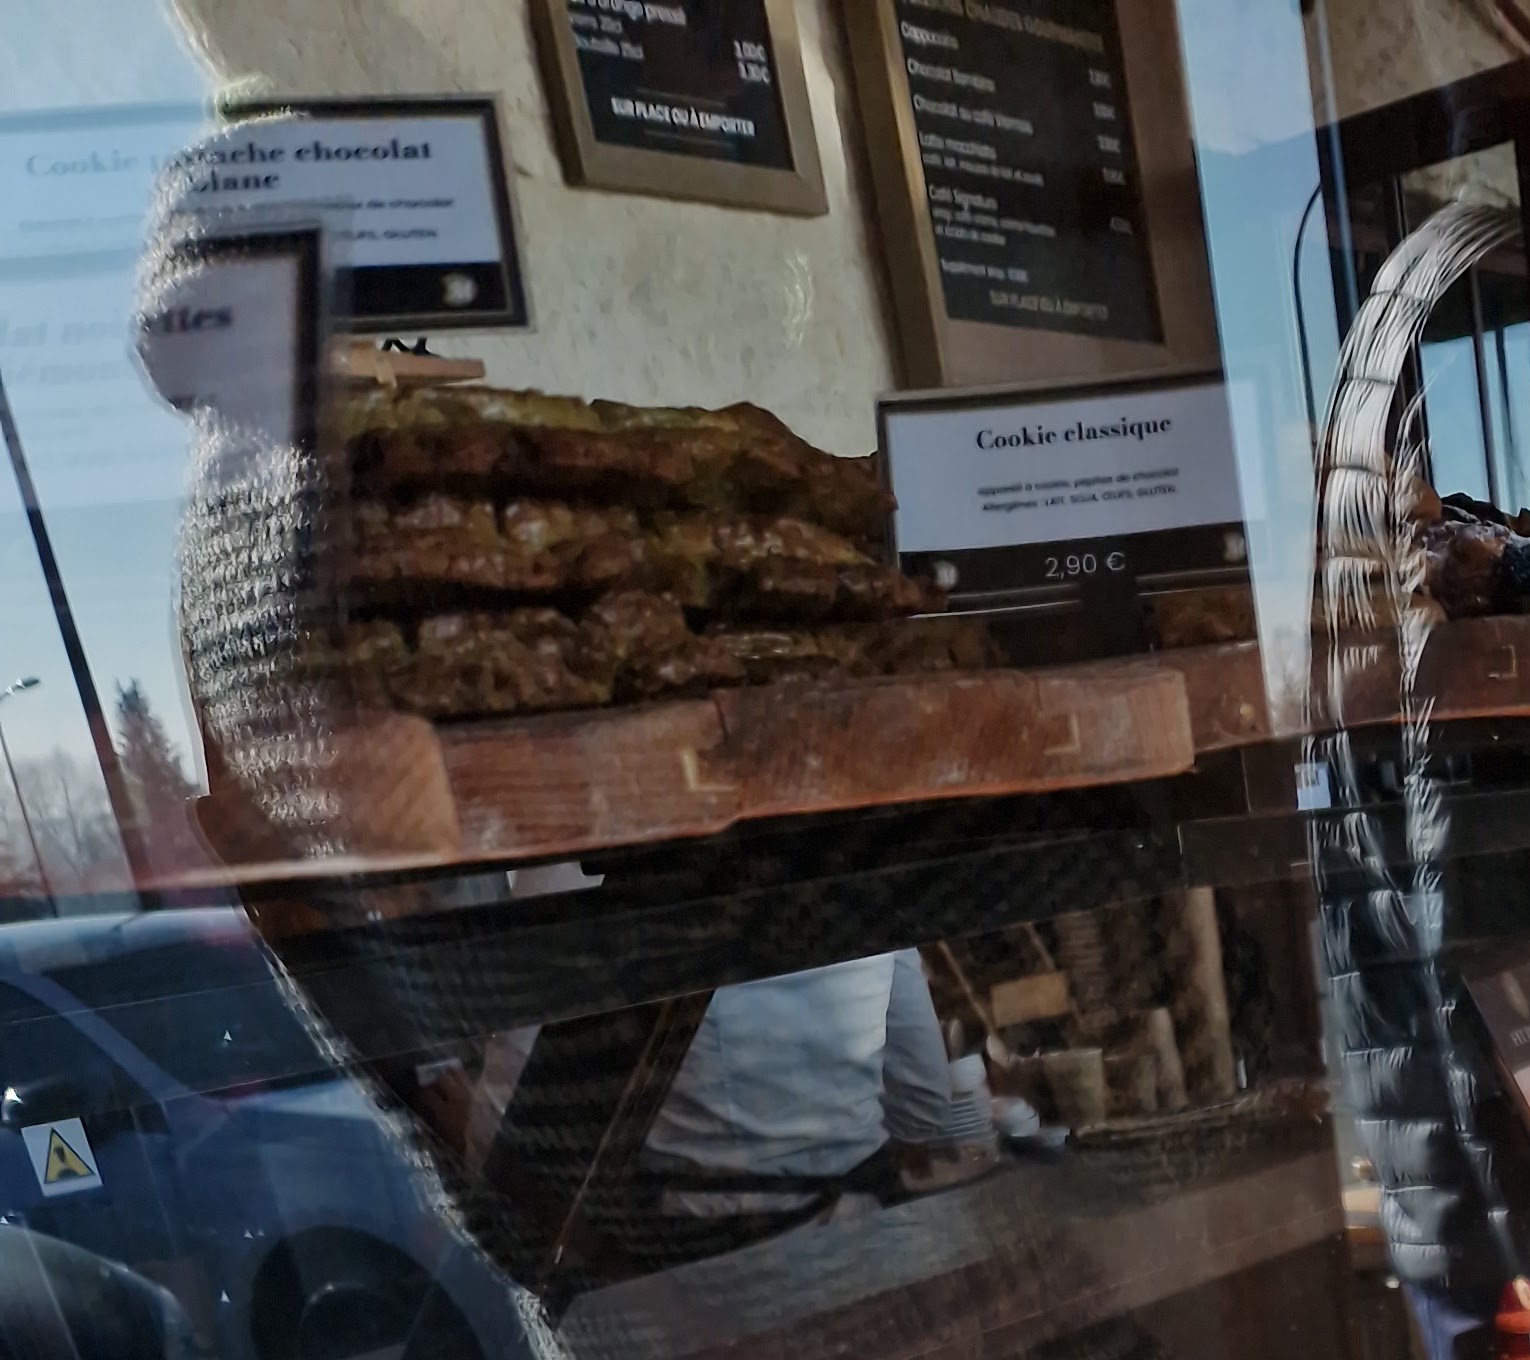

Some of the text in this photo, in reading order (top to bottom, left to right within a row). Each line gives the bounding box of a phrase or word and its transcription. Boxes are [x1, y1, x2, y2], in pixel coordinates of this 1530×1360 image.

[634, 99, 670, 122] PLACE
[293, 138, 433, 163] chocolat
[977, 416, 1172, 450] Cookie classique
[1045, 551, 1127, 581] 2,90 €
